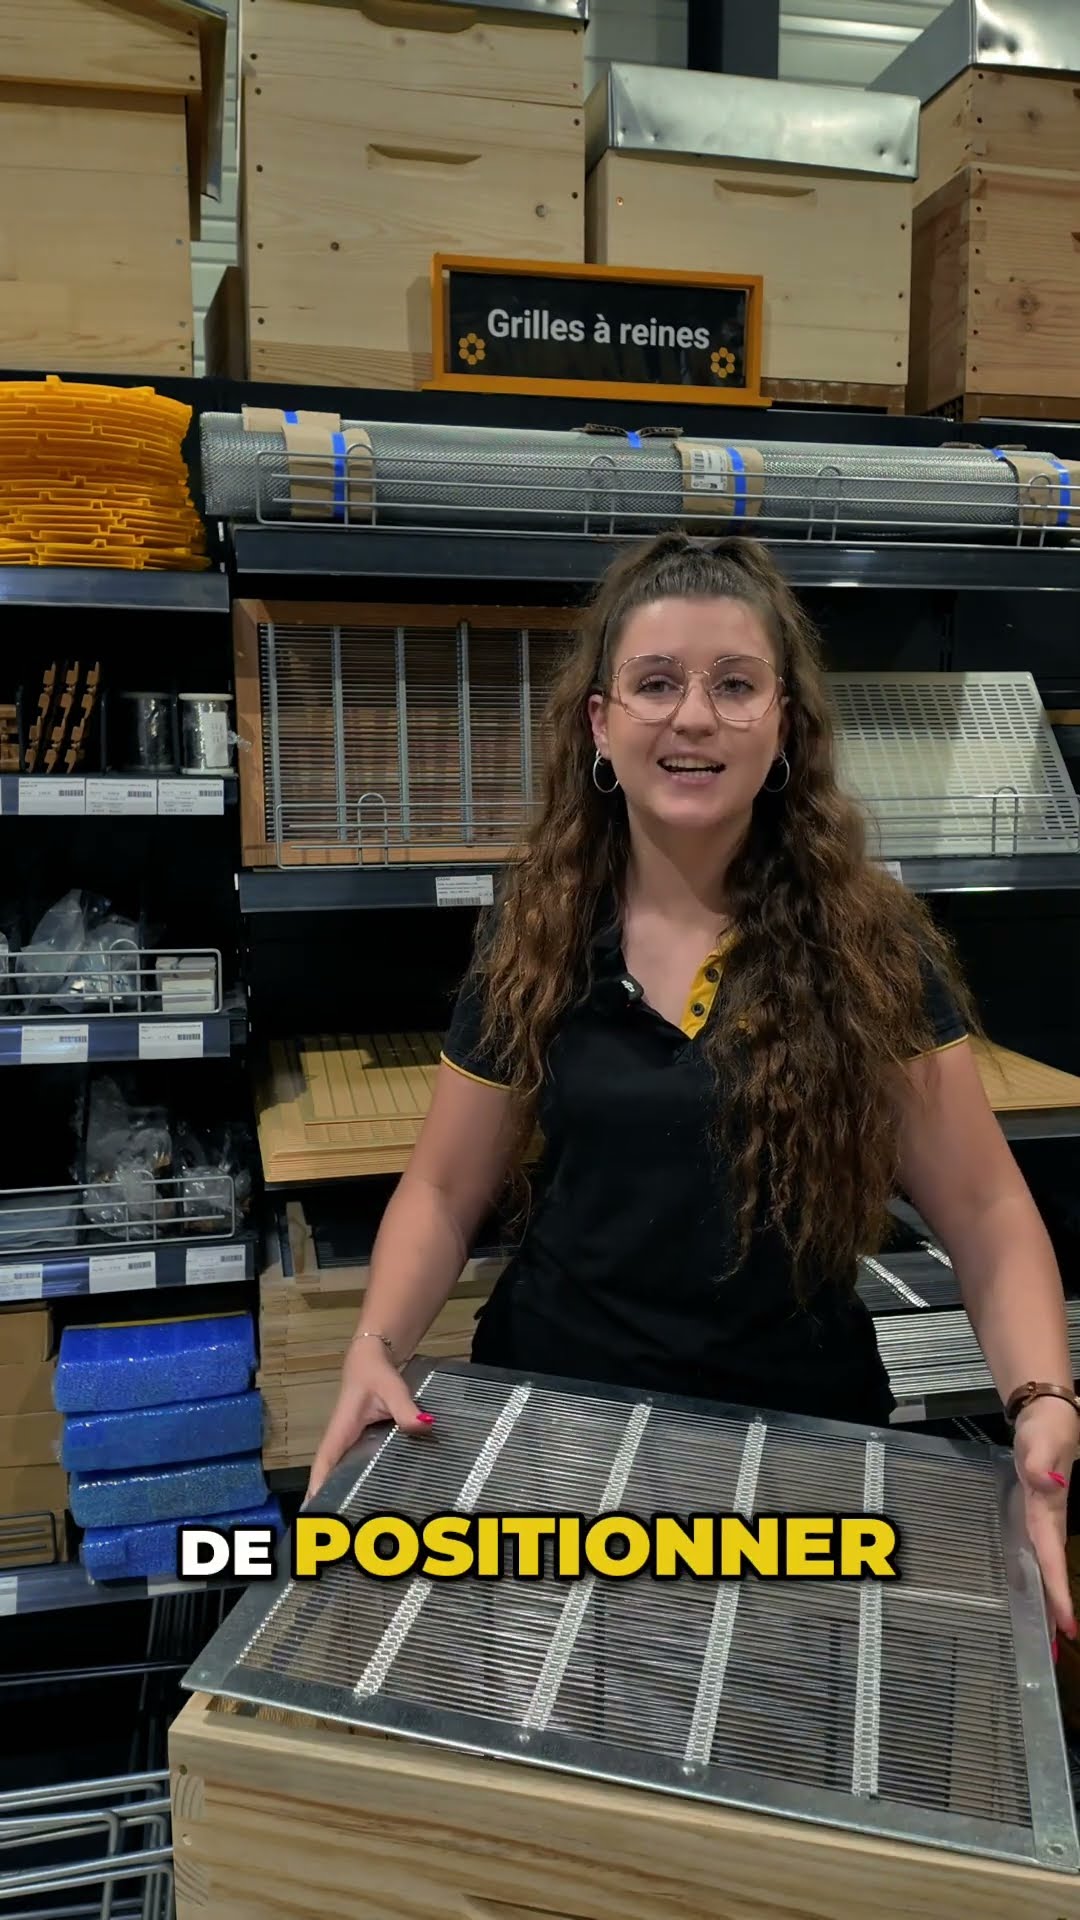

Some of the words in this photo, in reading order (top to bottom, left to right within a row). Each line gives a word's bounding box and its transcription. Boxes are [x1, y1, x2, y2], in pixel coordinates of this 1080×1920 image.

[487, 308, 585, 343] Grilles
[593, 313, 611, 344] à
[620, 317, 711, 349] reines
